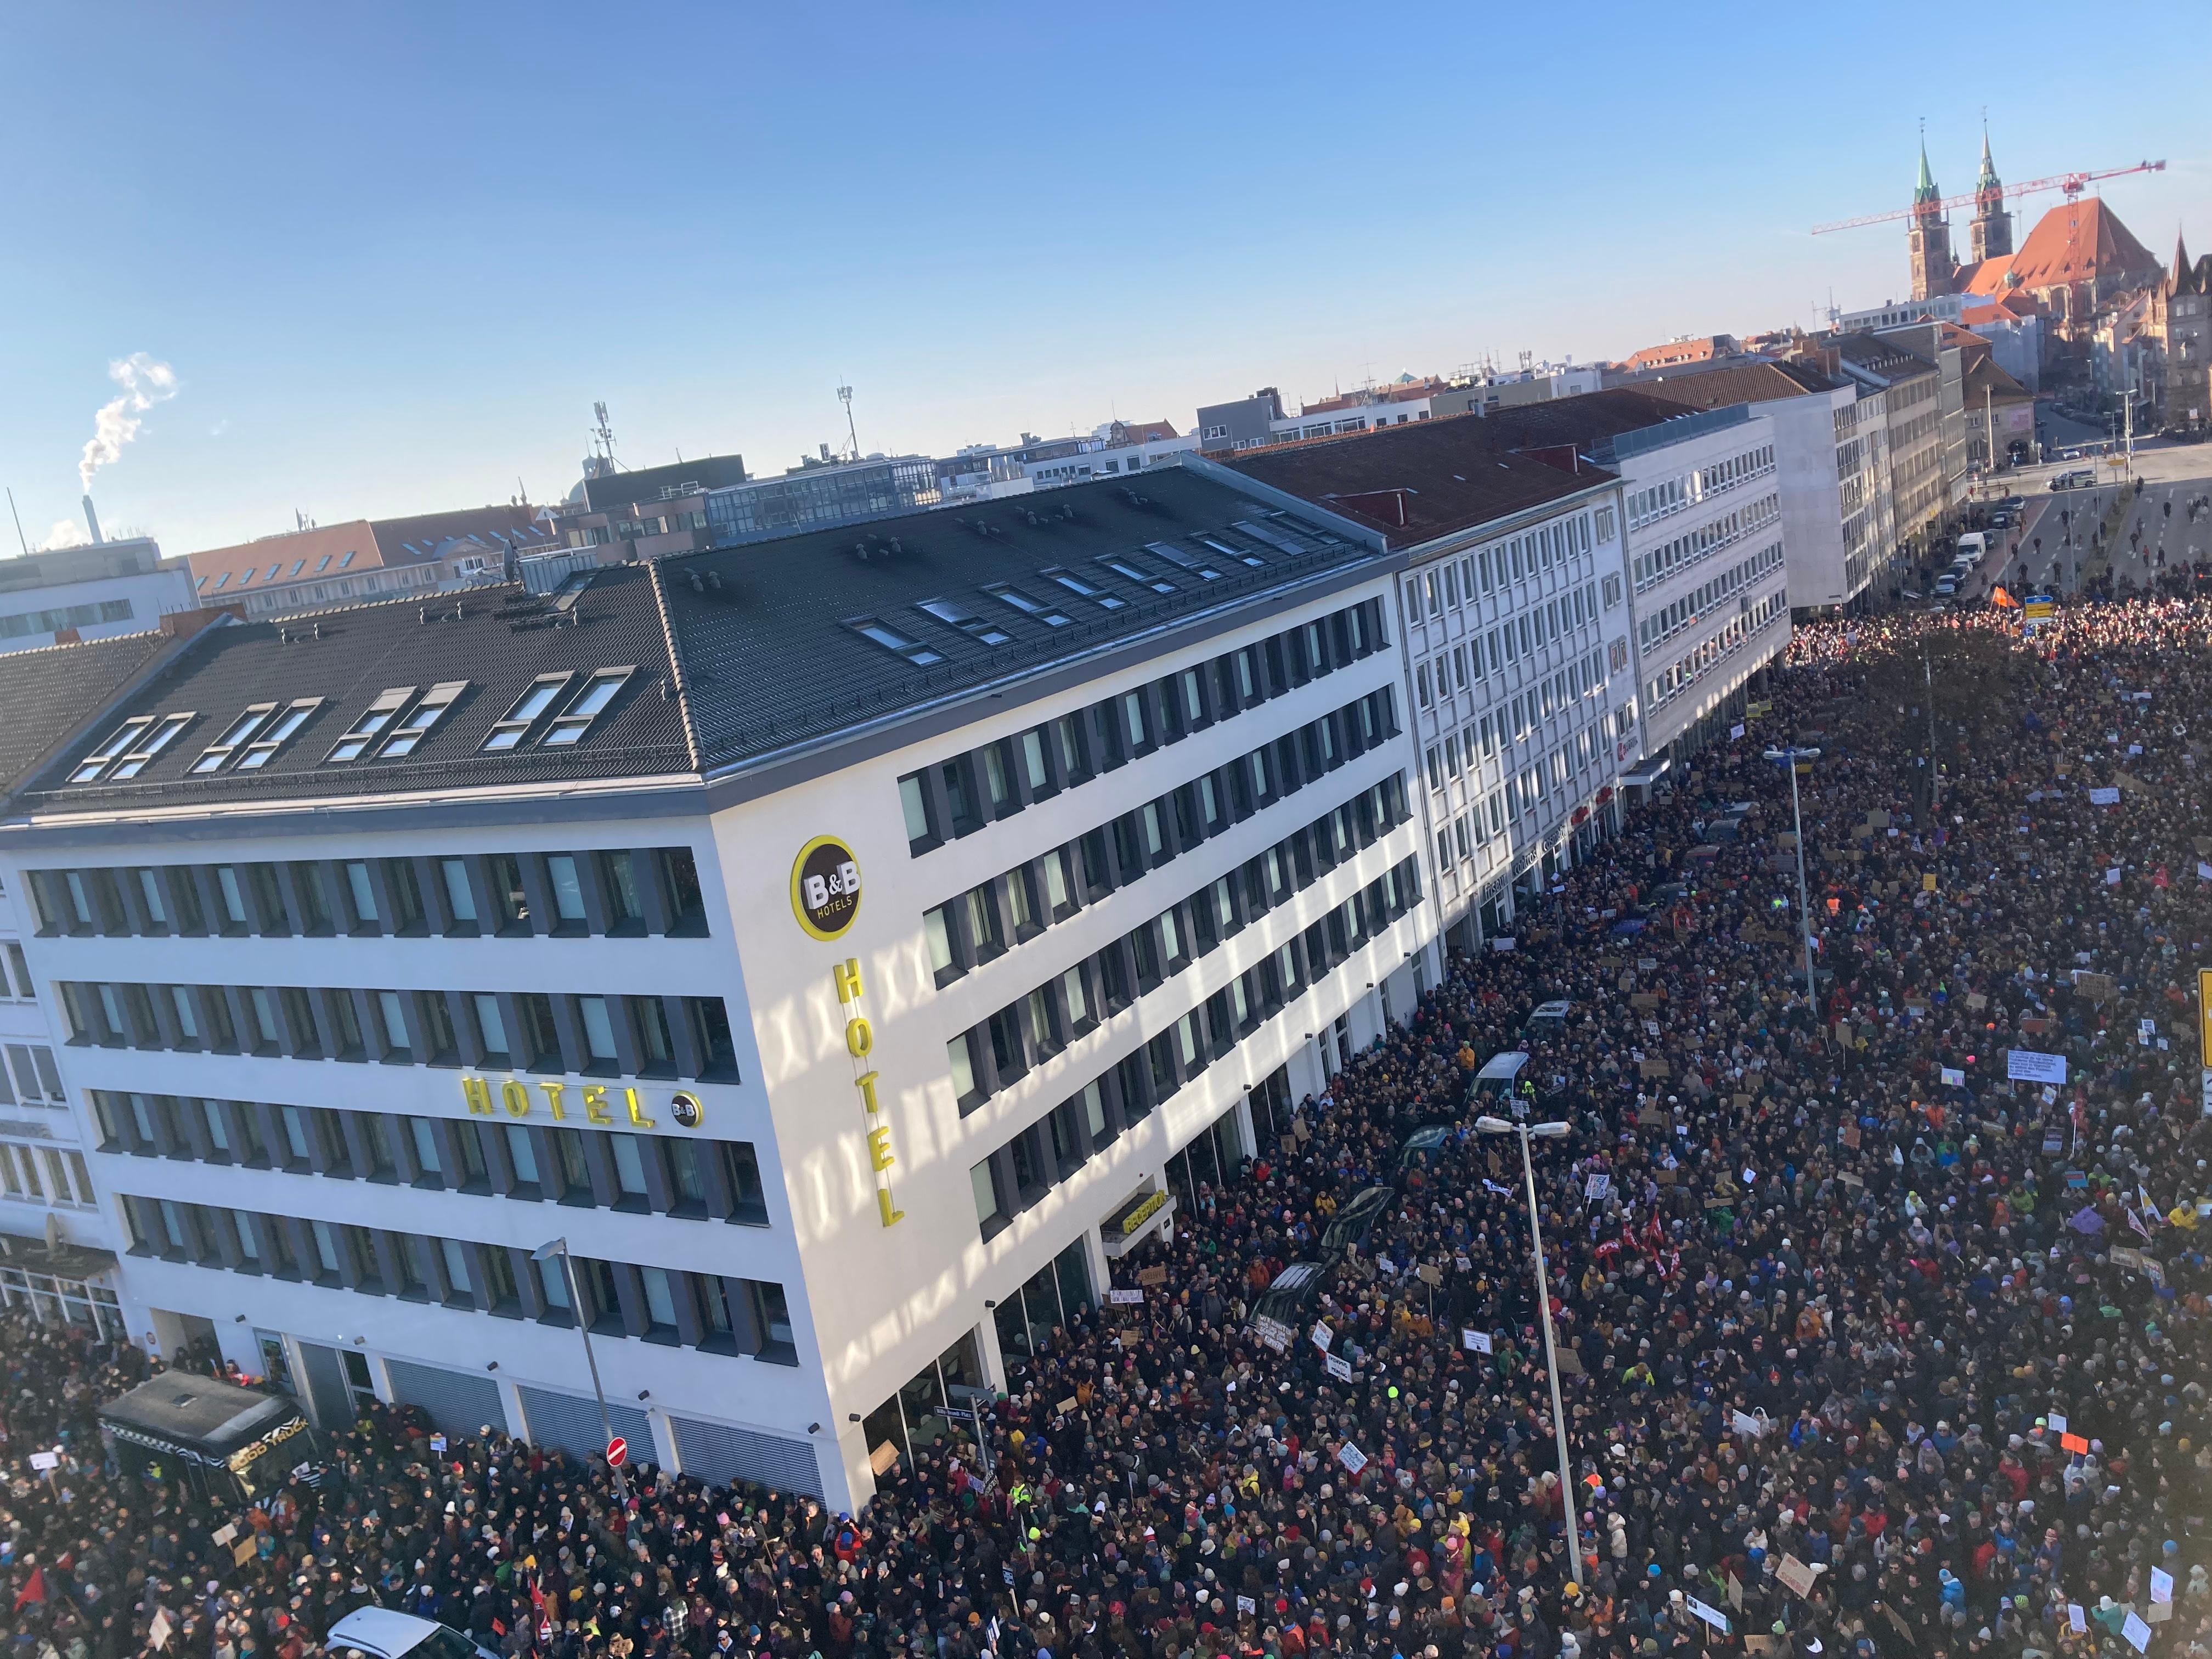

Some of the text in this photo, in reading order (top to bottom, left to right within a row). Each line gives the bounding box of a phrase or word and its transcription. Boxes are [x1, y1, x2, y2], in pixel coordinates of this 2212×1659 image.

[804, 860, 861, 910] B&B
[817, 895, 853, 919] HOTELS
[462, 1077, 696, 1128] HOTEL B&B
[833, 958, 905, 1227] HOTEL
[1122, 1189, 1166, 1235] RECEPTION
[270, 1418, 309, 1446] TRUCK
[936, 1408, 972, 1418] Willy-Brandt-Platz
